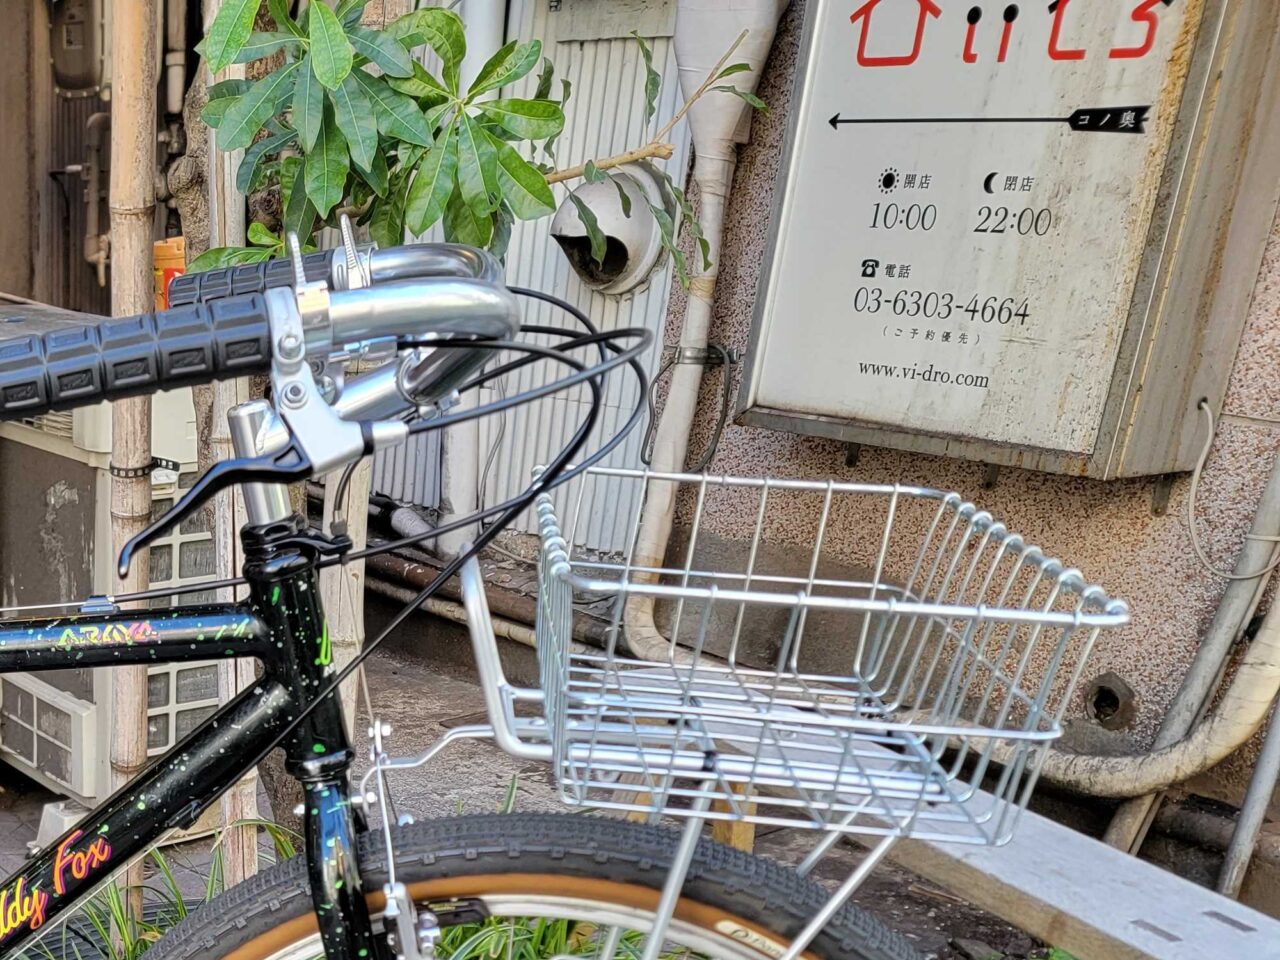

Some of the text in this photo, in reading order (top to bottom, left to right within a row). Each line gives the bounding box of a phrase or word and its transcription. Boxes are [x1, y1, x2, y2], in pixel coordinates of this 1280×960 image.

[1078, 110, 1136, 129] コノ奥
[903, 174, 1034, 192] 開店 閉店
[869, 203, 1052, 236] 10:00 22:00
[884, 263, 912, 279] 電話
[853, 286, 1030, 326] 03-6303-4664
[858, 362, 989, 388] www.vi-dro.com
[54, 829, 112, 895] Fox
